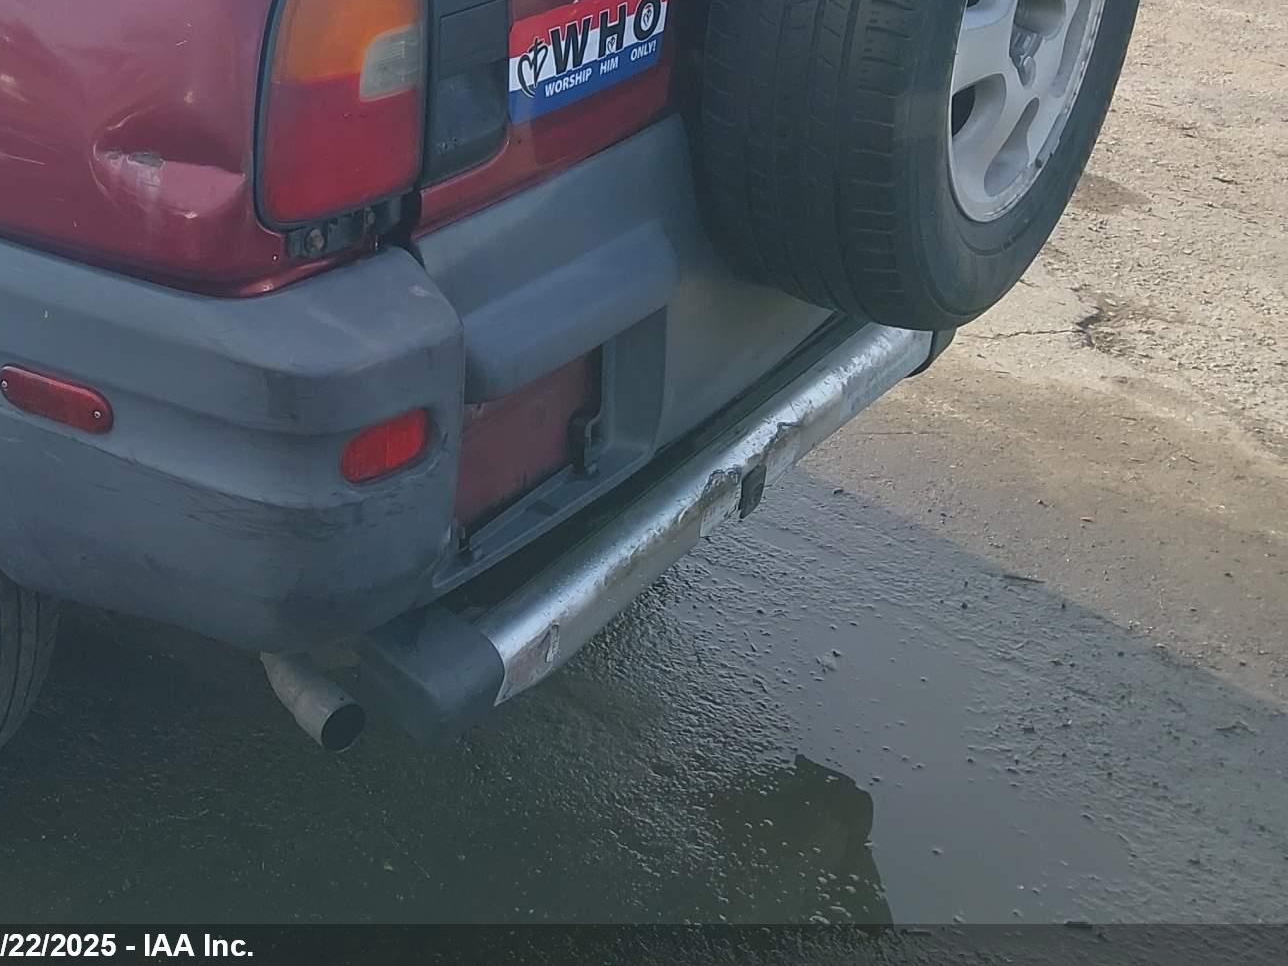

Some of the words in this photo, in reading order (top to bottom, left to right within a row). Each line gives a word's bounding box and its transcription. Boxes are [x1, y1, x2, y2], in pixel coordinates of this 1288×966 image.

[544, 67, 592, 98] WORSHIP
[599, 56, 619, 75] HIM
[630, 38, 657, 62] ONLY!
